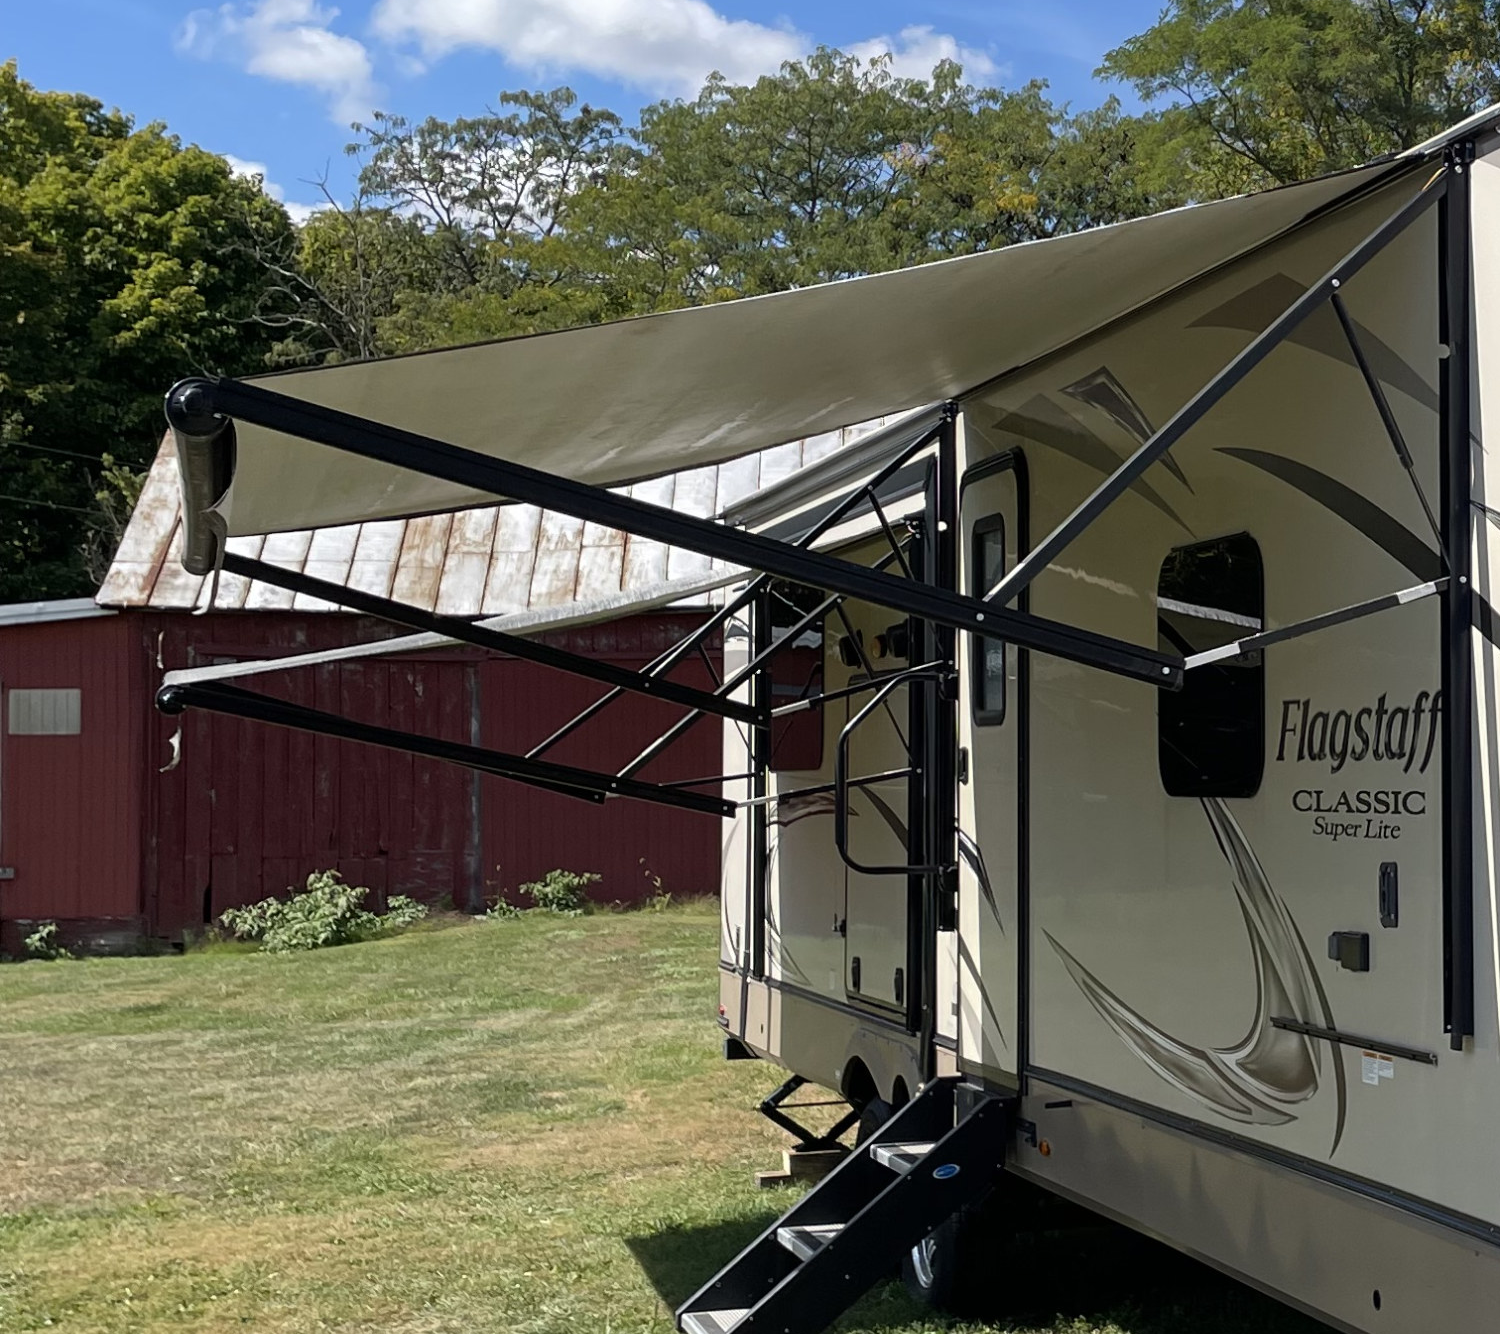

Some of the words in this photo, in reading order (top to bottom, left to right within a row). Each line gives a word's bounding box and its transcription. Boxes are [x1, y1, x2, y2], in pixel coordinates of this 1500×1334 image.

[1276, 690, 1442, 774] Flagstaff
[1292, 789, 1426, 815] CLASSIC
[1312, 816, 1361, 841] Super
[1364, 819, 1401, 839] Lite
